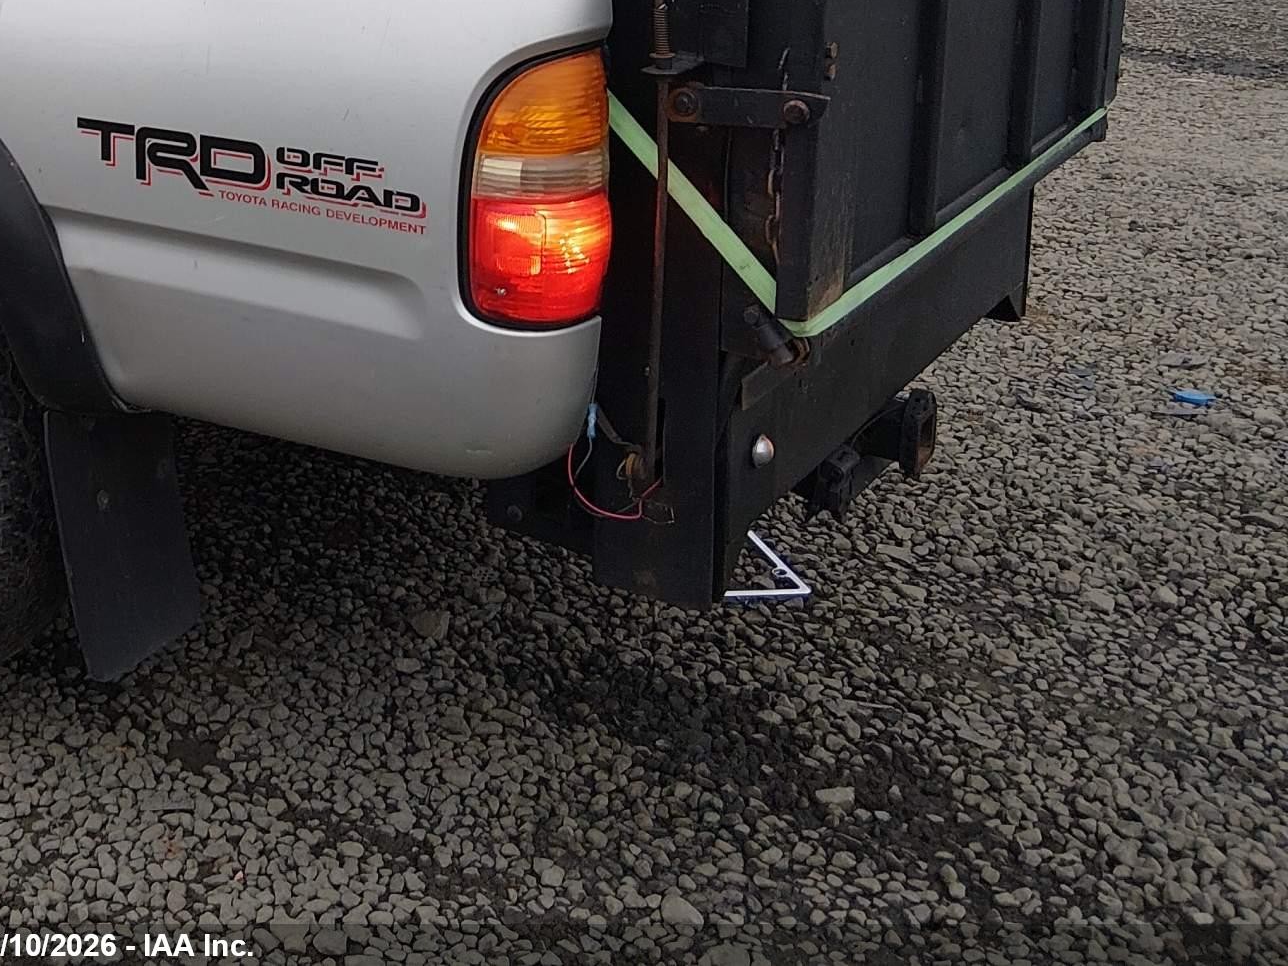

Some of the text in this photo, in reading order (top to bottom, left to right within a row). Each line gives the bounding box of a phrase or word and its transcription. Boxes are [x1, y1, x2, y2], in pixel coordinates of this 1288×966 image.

[76, 116, 272, 197] TRD
[275, 146, 384, 181] OFF
[218, 189, 427, 235] TOYOTA RACING DEVELOPMENT
[275, 172, 427, 219] ROAD
